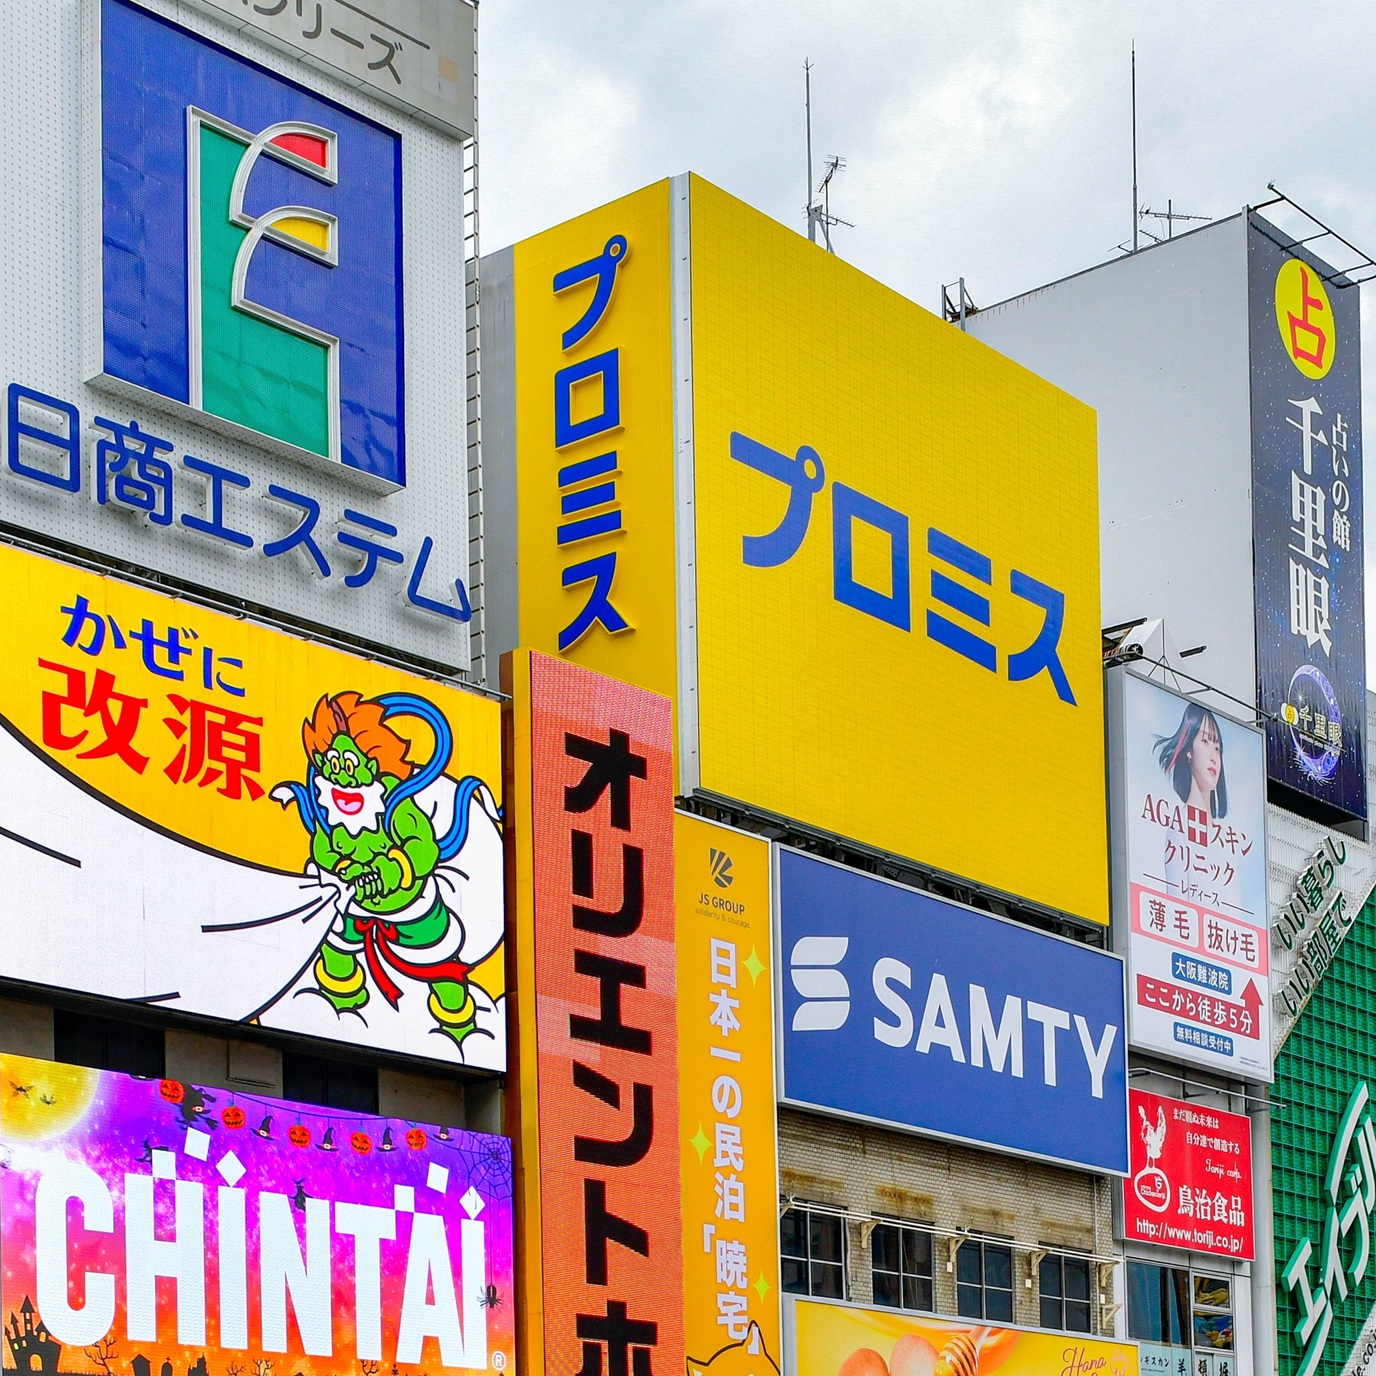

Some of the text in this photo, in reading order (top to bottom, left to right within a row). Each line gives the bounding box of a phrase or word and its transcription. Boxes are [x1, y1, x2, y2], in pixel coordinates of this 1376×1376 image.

[1287, 266, 1325, 370] 占
[553, 233, 635, 653] プロミス
[1330, 413, 1350, 553] 占いの館
[7, 382, 471, 623] 日商エステム
[1286, 396, 1332, 659] 千里眼
[730, 430, 1078, 707] プロミス
[60, 594, 246, 698] かぜに
[38, 657, 266, 802] 改源
[1141, 792, 1254, 858] AGA スキン
[1164, 840, 1235, 887] クリニック
[698, 893, 745, 916] JS GROUP
[1148, 898, 1257, 963] 薄毛 抜け毛
[1180, 879, 1221, 907] レディース
[1274, 836, 1347, 951] いい暮らし
[1174, 958, 1230, 993] 大阪難波院
[1277, 891, 1351, 1017] いい部屋で
[872, 957, 1118, 1099] SAMTY
[1144, 982, 1254, 1035] ここから徒歩5分
[1176, 1025, 1233, 1055] 無料相談受付中
[1136, 1217, 1244, 1253] http://www.toriji.co.jp/
[1177, 1184, 1245, 1227] 鳥治食品
